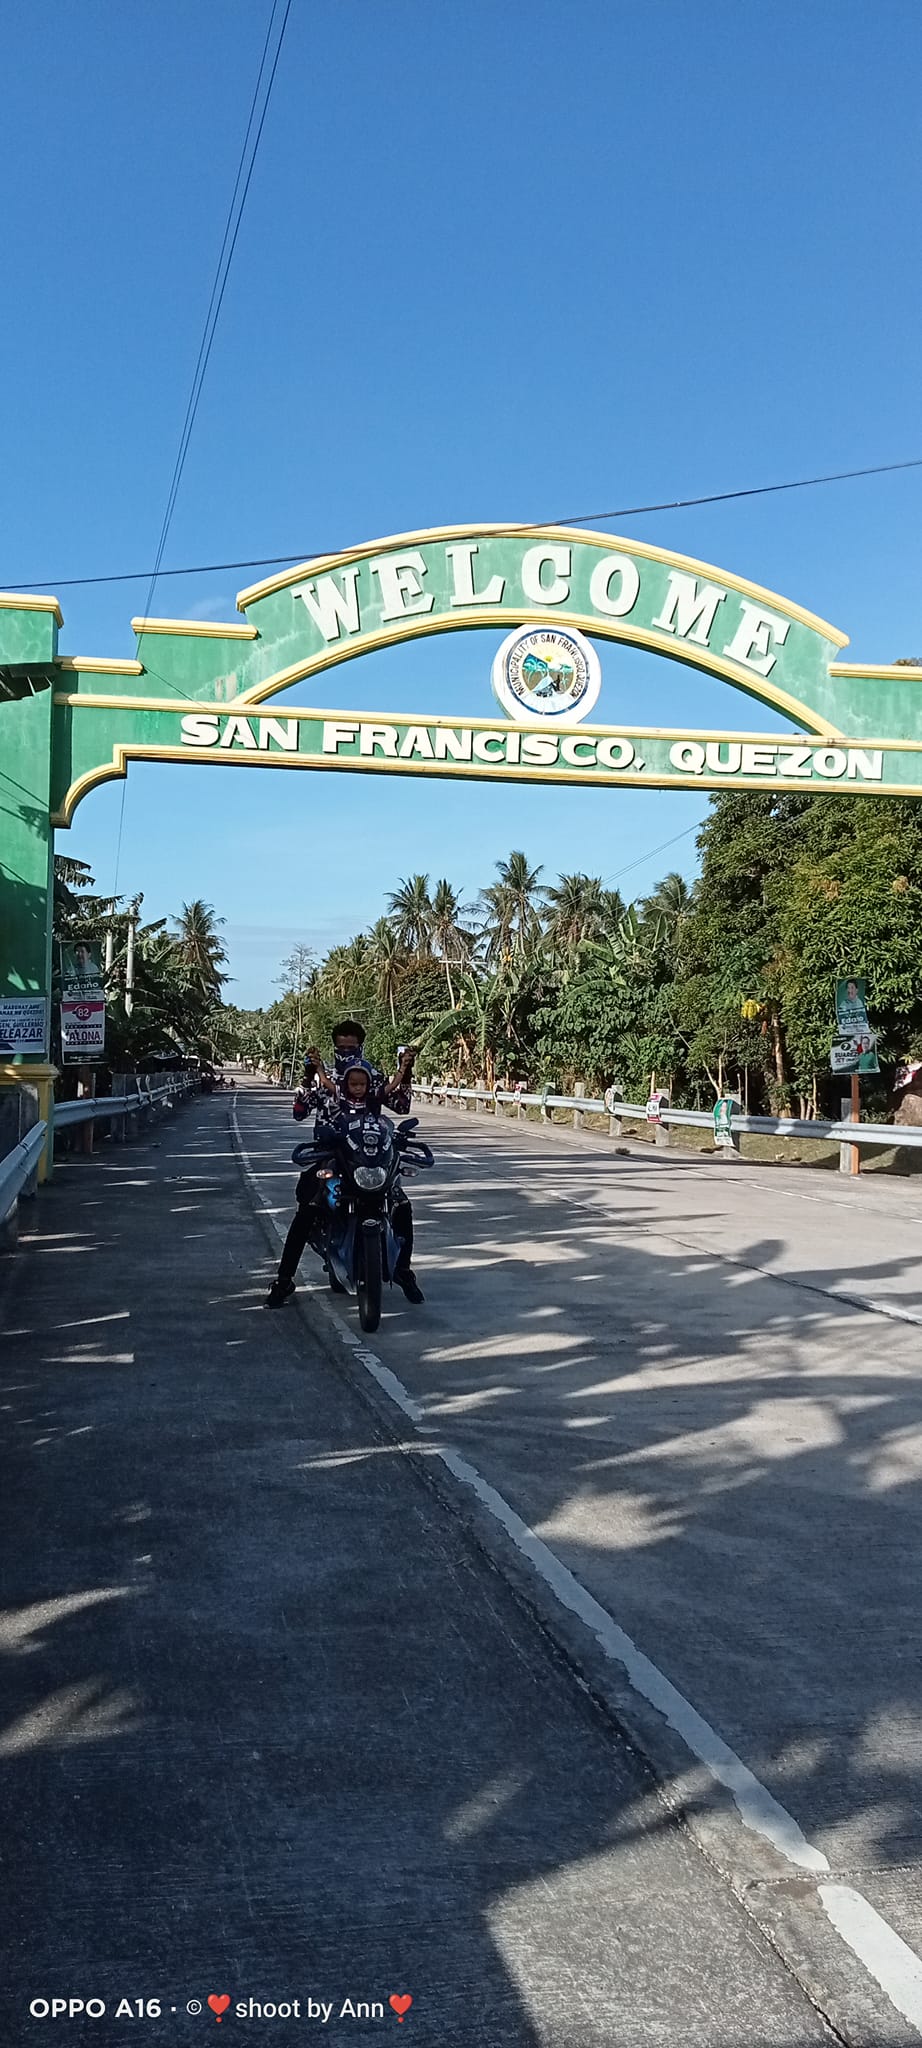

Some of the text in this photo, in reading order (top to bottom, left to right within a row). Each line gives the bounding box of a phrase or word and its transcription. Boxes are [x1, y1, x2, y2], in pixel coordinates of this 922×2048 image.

[291, 543, 791, 677] WELCOME
[509, 640, 529, 696] MUNICIPALITY
[530, 636, 538, 646] OF
[540, 633, 557, 644] SAN
[180, 713, 885, 780] SAN FRANCISCO, QUEZON
[69, 1030, 101, 1041] ALONA
[78, 1008, 89, 1017] 82
